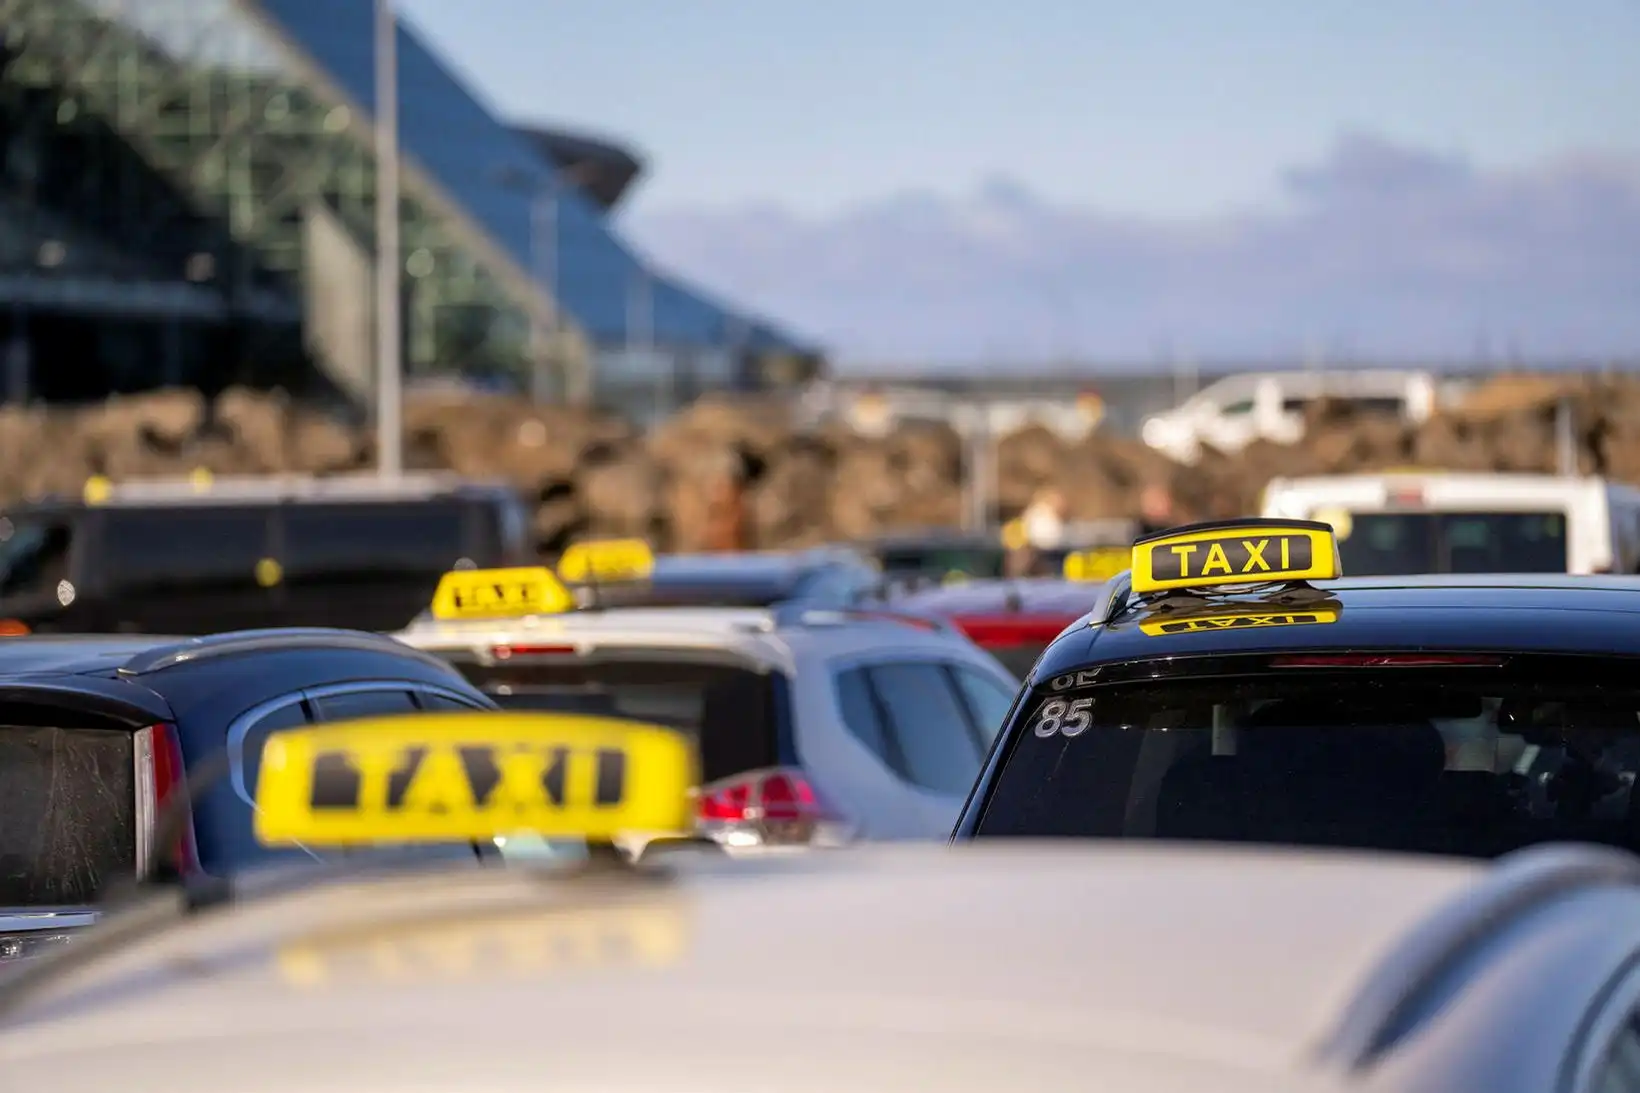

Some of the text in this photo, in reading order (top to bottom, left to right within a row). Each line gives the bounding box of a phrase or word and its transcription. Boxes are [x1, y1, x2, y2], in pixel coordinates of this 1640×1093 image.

[1170, 537, 1291, 577] TAXI
[1034, 697, 1094, 738] 85
[340, 744, 598, 812] TAXI
